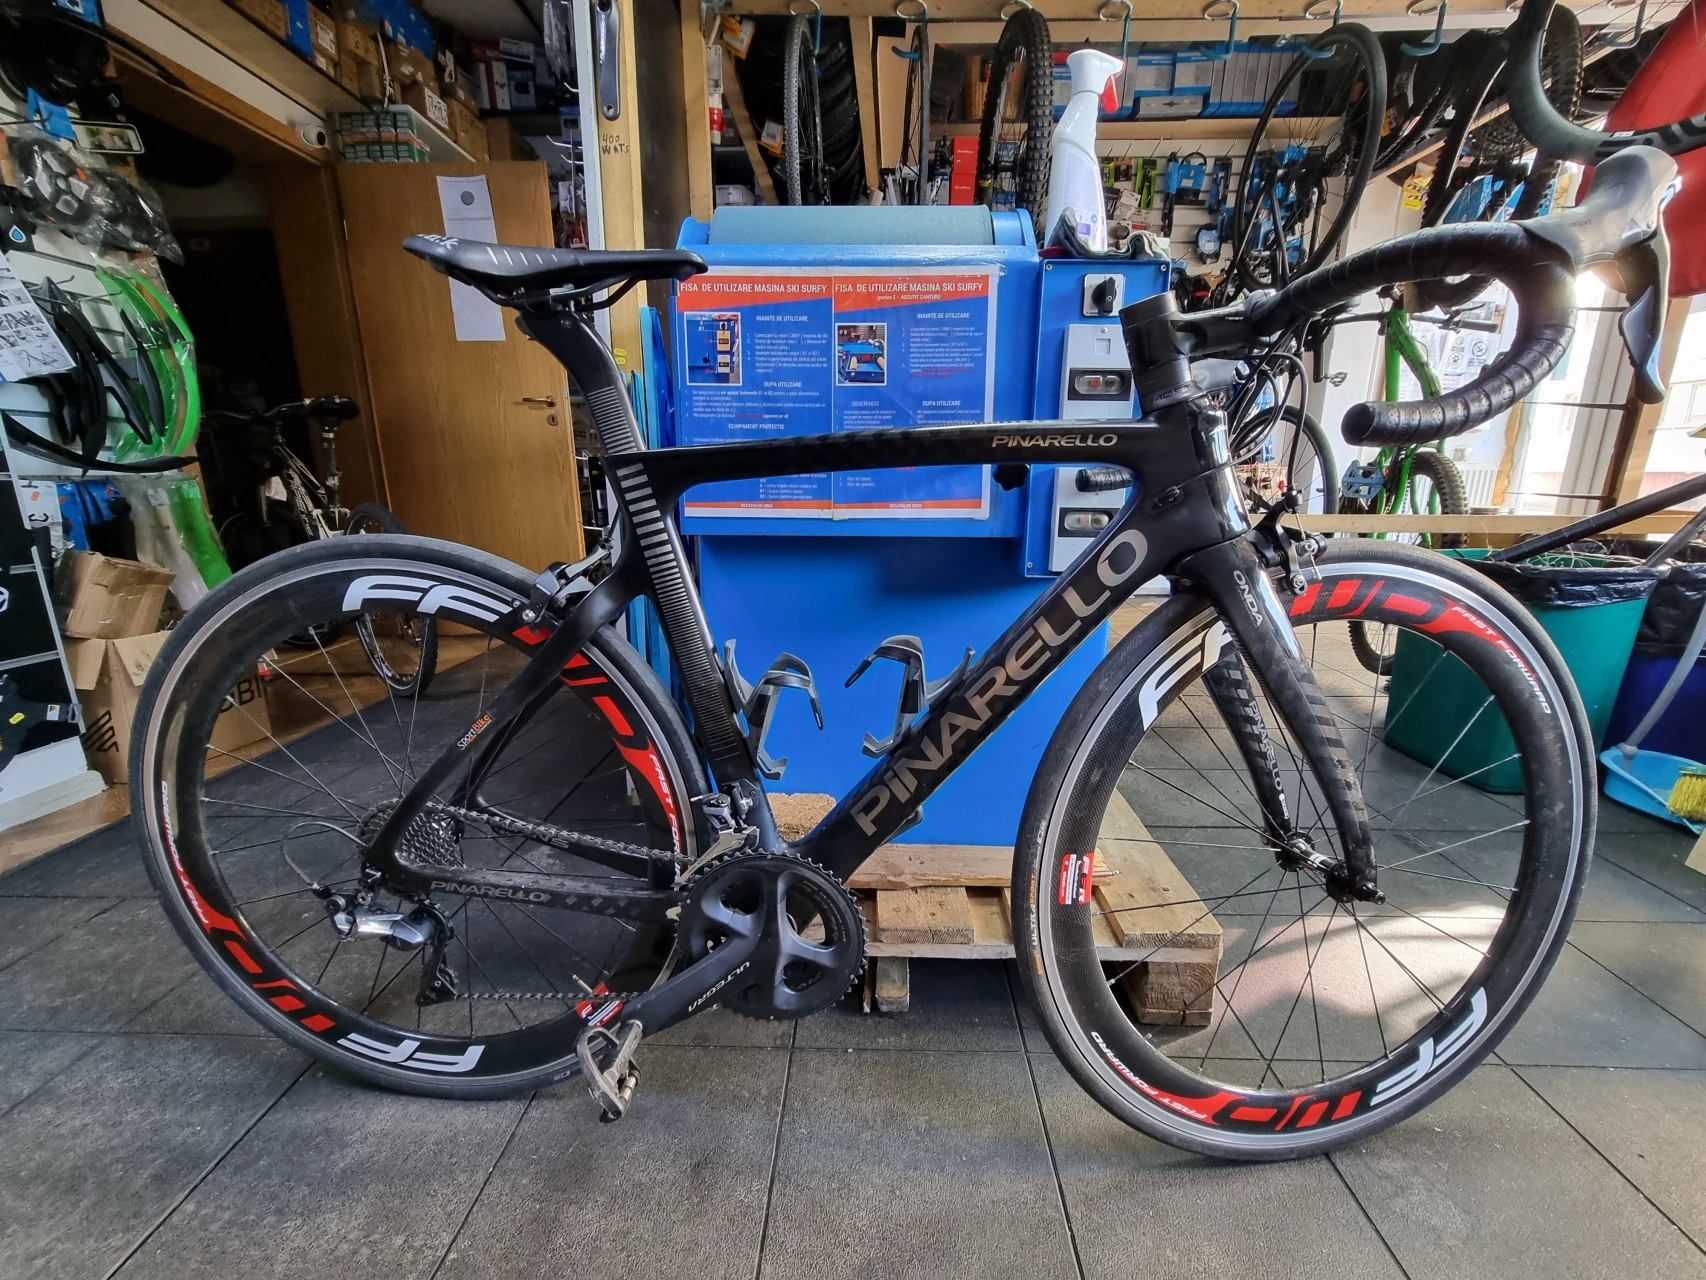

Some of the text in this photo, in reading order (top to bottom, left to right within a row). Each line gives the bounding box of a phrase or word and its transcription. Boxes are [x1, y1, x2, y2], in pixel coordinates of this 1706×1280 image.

[603, 134, 620, 144] 400
[680, 283, 828, 292] FISA DE UTILIZARE MASINA SKI SURFY
[835, 282, 984, 292] FISA DE UTILIZARE MASINA SKI SURFY
[992, 434, 1118, 448] PINARELLO
[1233, 570, 1263, 627] ONDA
[850, 529, 1148, 836] PINARELLO
[1452, 606, 1552, 714] FAST FORWARD
[1248, 700, 1283, 790] PINARELLO
[650, 754, 674, 808] FAST
[180, 876, 210, 924] FAST
[430, 880, 548, 902] PINARELLO
[688, 961, 750, 1012] ULTEGRA
[1090, 1031, 1208, 1120] FAST FORWARD
